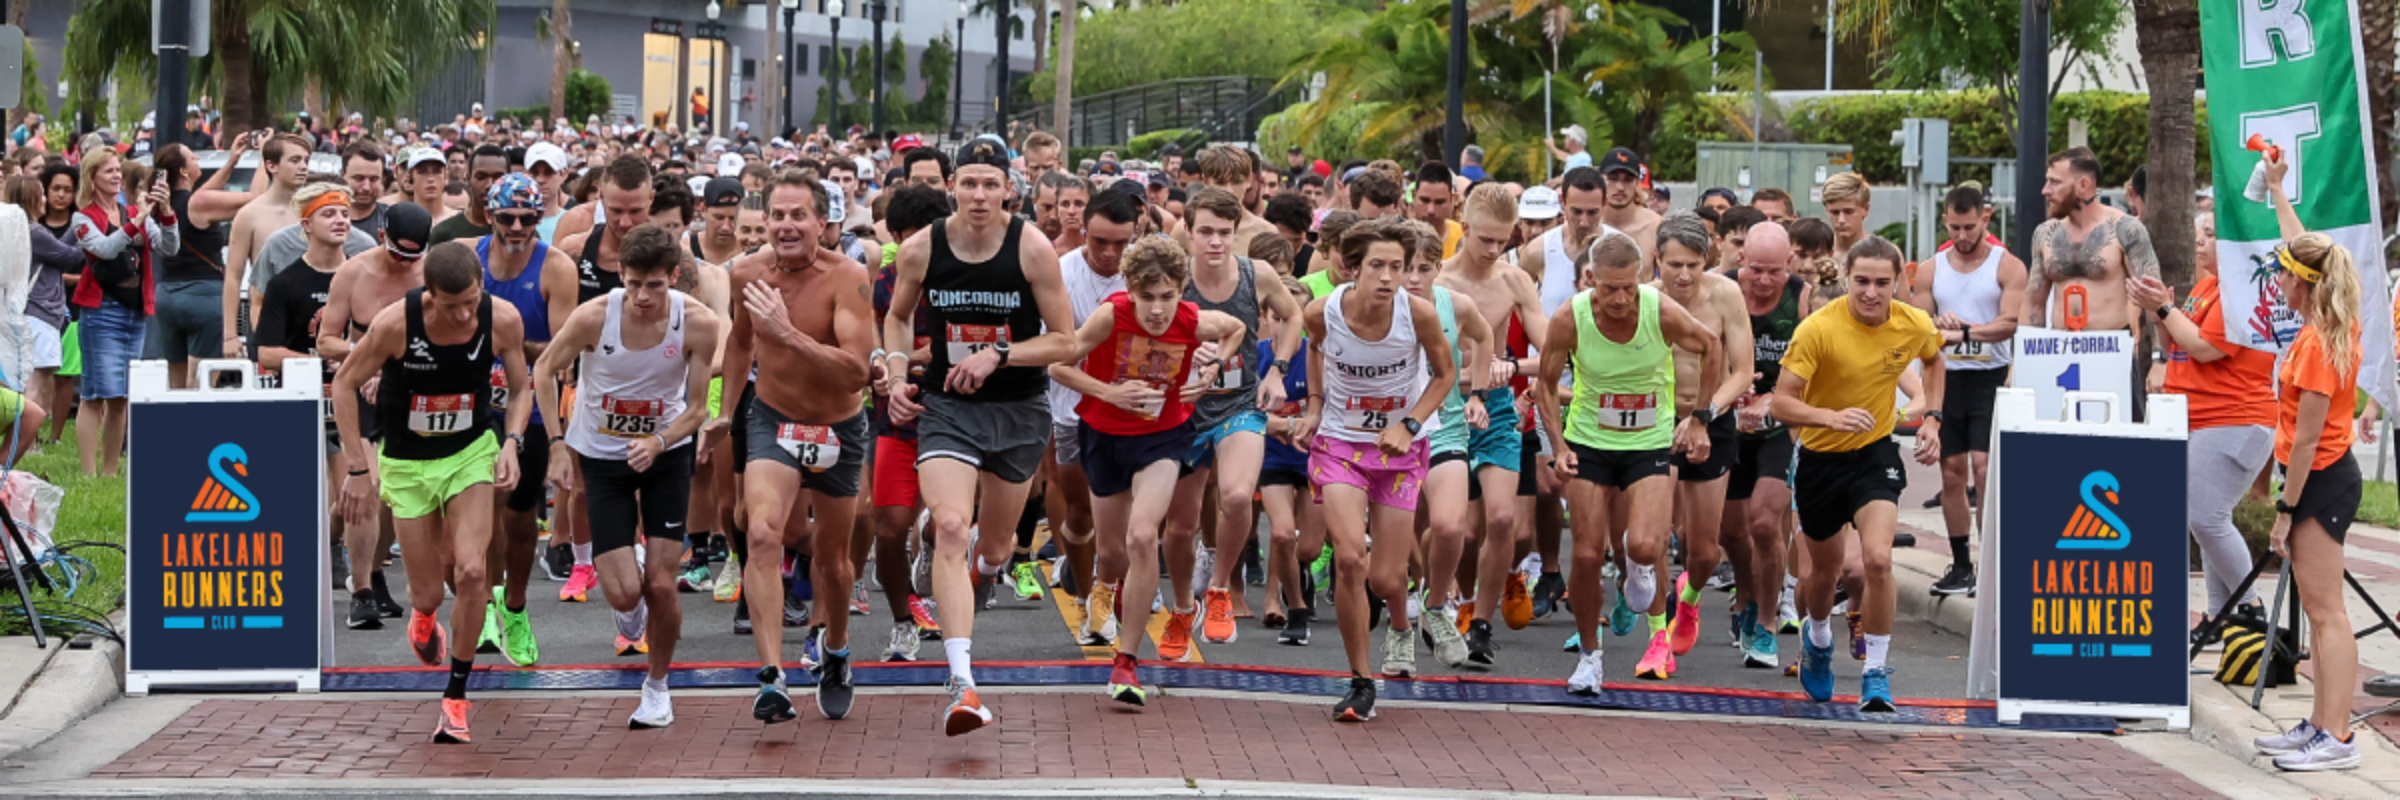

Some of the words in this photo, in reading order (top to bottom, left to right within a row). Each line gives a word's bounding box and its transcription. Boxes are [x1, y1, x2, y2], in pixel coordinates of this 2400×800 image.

[929, 289, 1021, 308] CONCORDIA
[1753, 333, 1791, 350] ulber
[2024, 337, 2059, 356] WAVE
[2071, 336, 2120, 354] CORRAL
[1336, 359, 1407, 378] KNIGHTS
[426, 412, 459, 431] 117
[606, 413, 657, 434] 1235
[1362, 410, 1389, 429] 25
[1618, 411, 1637, 427] 11
[796, 443, 820, 464] 13
[163, 532, 283, 567] LAKELAND
[2032, 559, 2153, 595] LAKELAND
[163, 571, 284, 607] RUNNERS
[211, 615, 236, 630] CLUB
[2032, 598, 2153, 636] RUNNERS
[2080, 642, 2105, 657] CLUB
